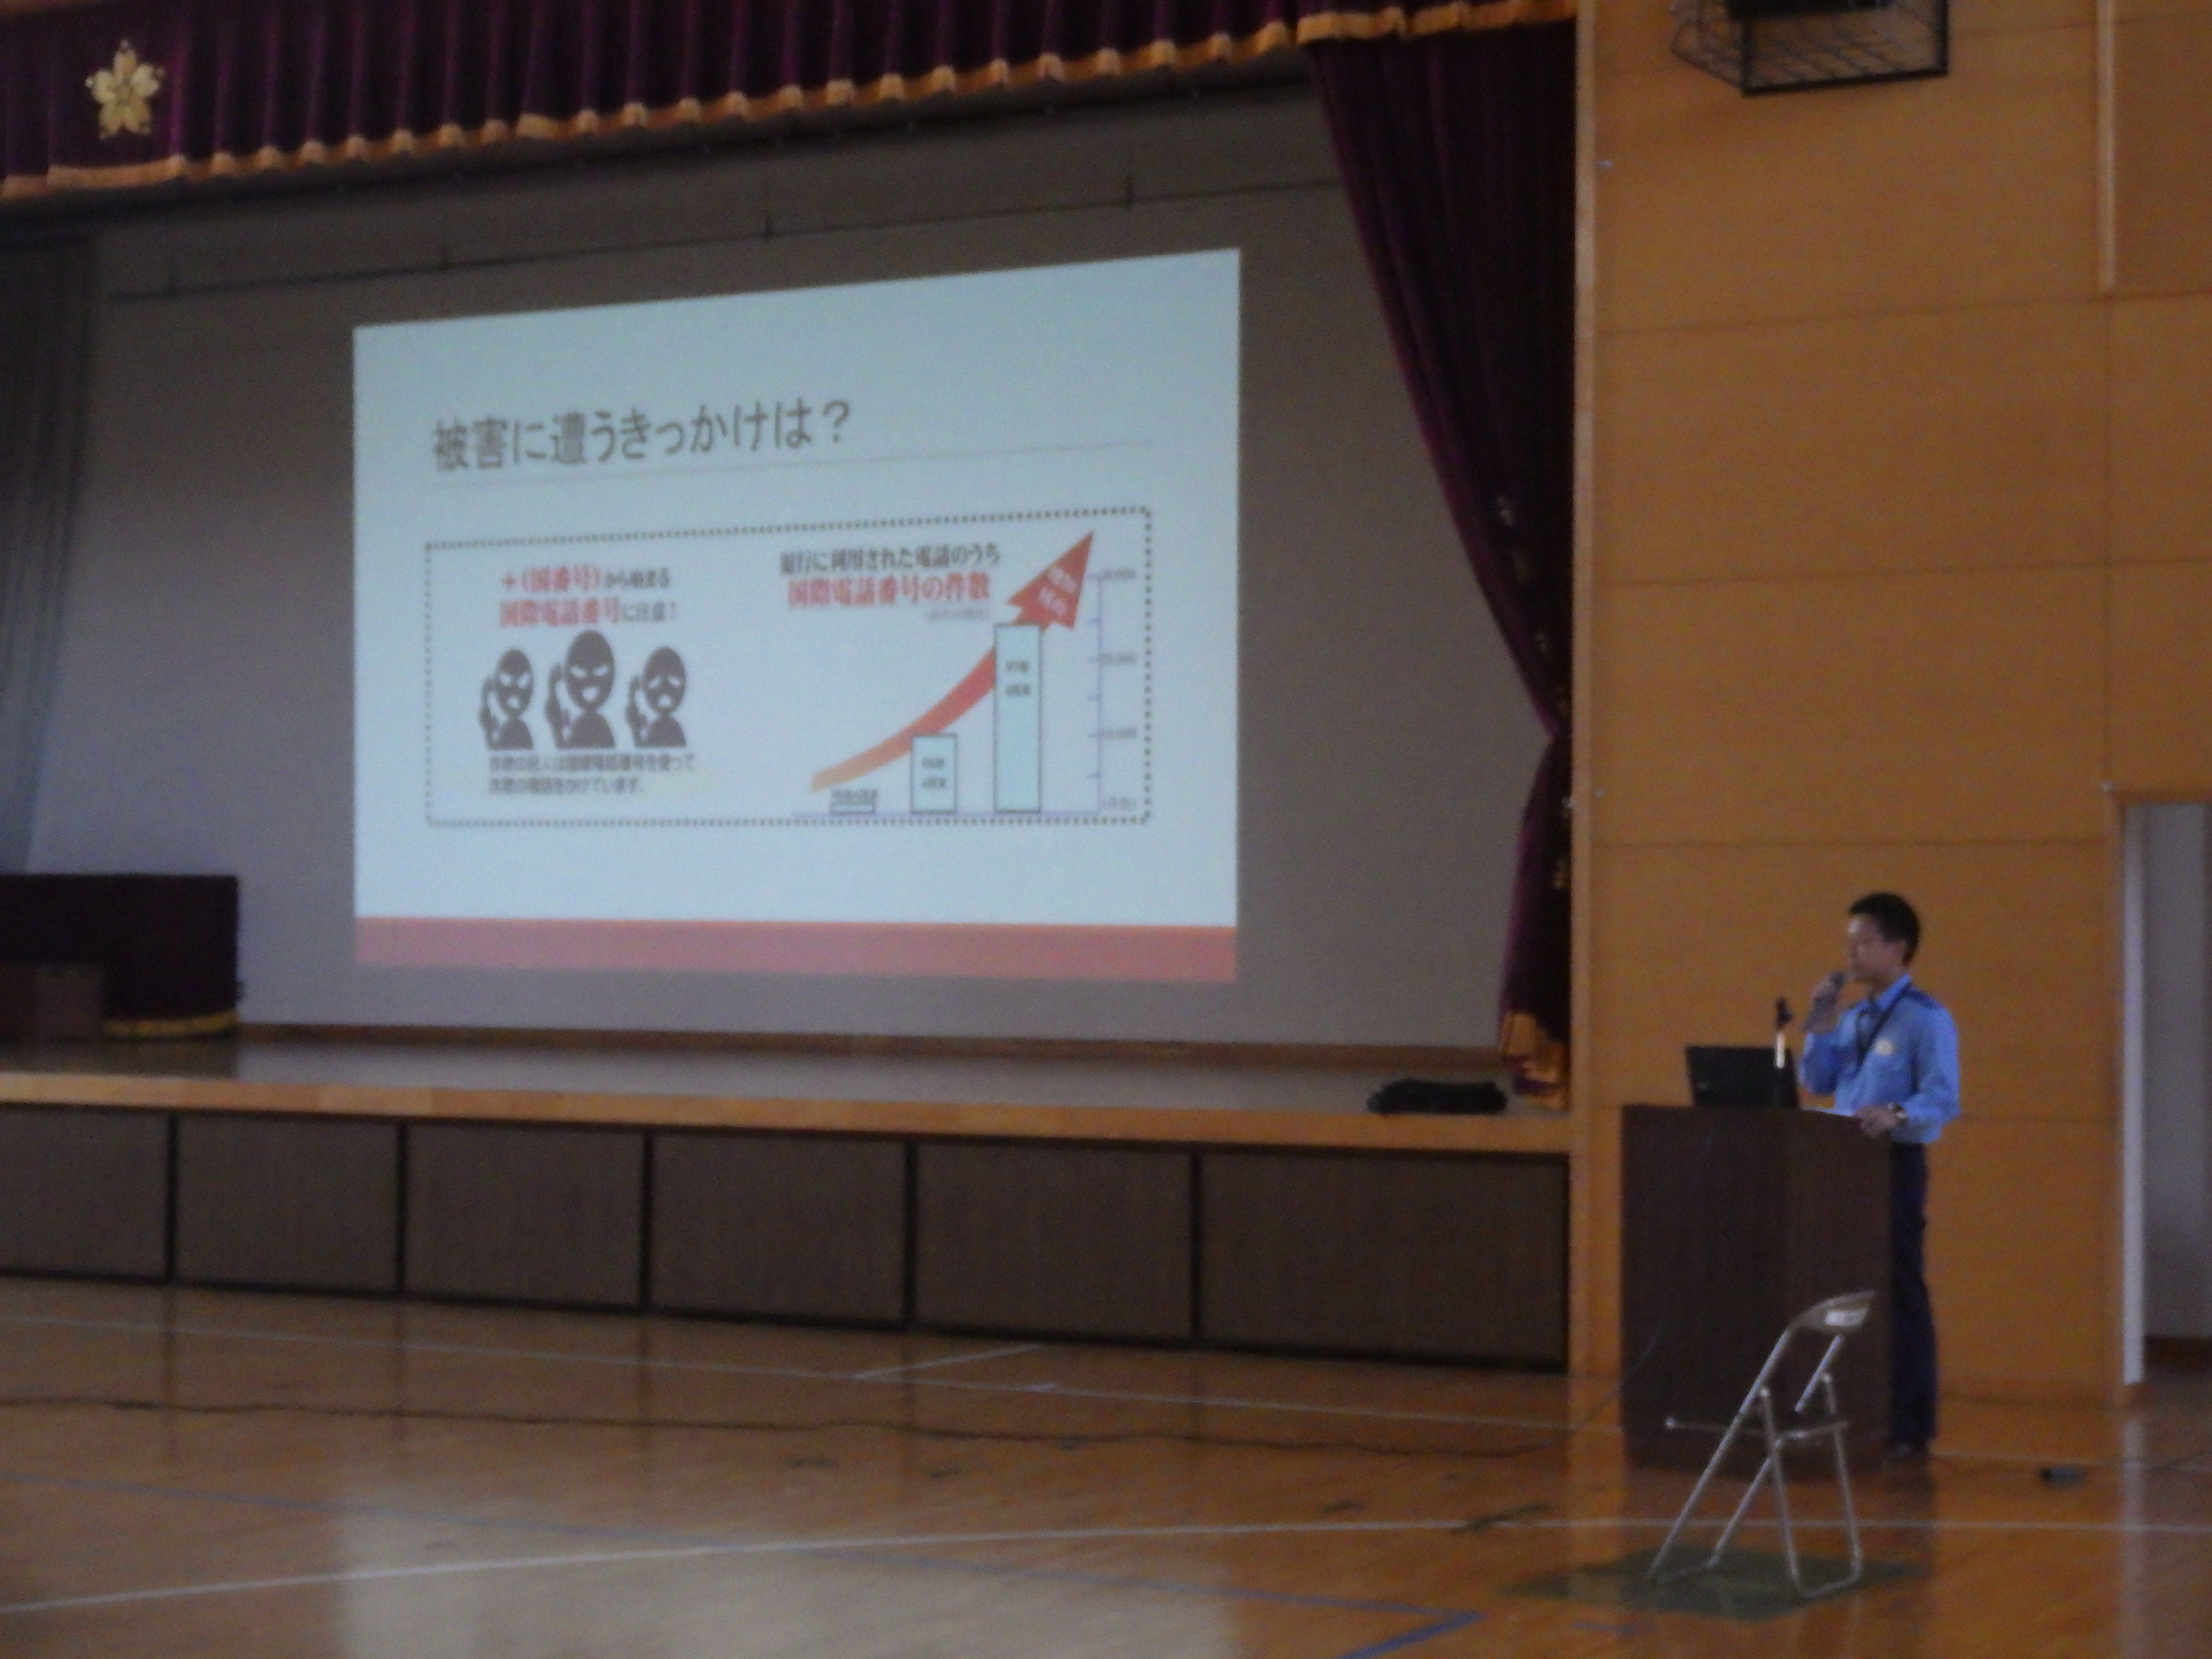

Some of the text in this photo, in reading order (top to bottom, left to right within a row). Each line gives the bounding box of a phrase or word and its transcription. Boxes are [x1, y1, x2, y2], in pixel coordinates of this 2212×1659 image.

[431, 398, 851, 471] 被害に遭うきっかけは?
[788, 571, 989, 607] 国際電話番号の件数
